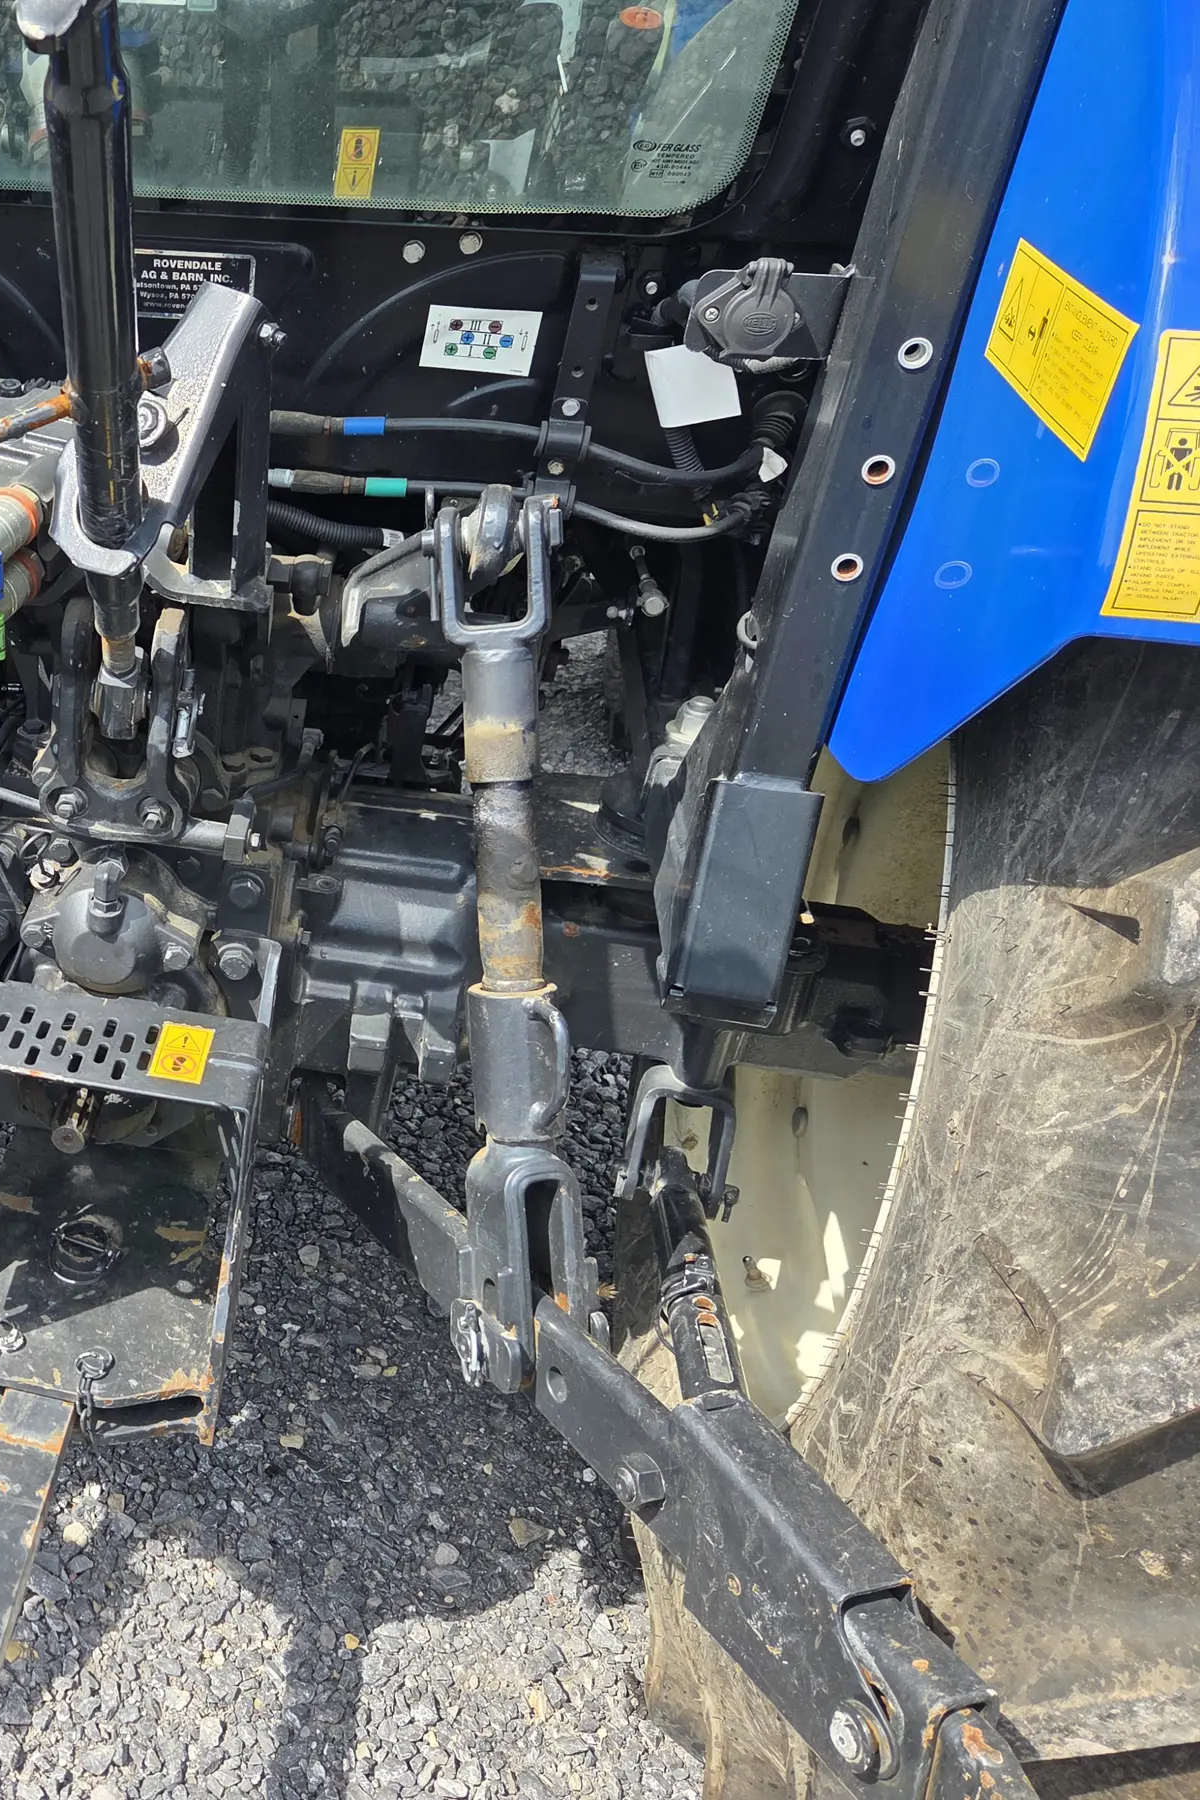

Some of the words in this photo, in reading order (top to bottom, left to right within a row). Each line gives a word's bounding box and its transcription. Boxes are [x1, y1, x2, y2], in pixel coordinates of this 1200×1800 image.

[153, 258, 222, 271] ROVENDALE
[141, 271, 157, 280] AG
[160, 271, 169, 280] &
[210, 274, 234, 283] INC.
[136, 282, 179, 291] atsontown,
